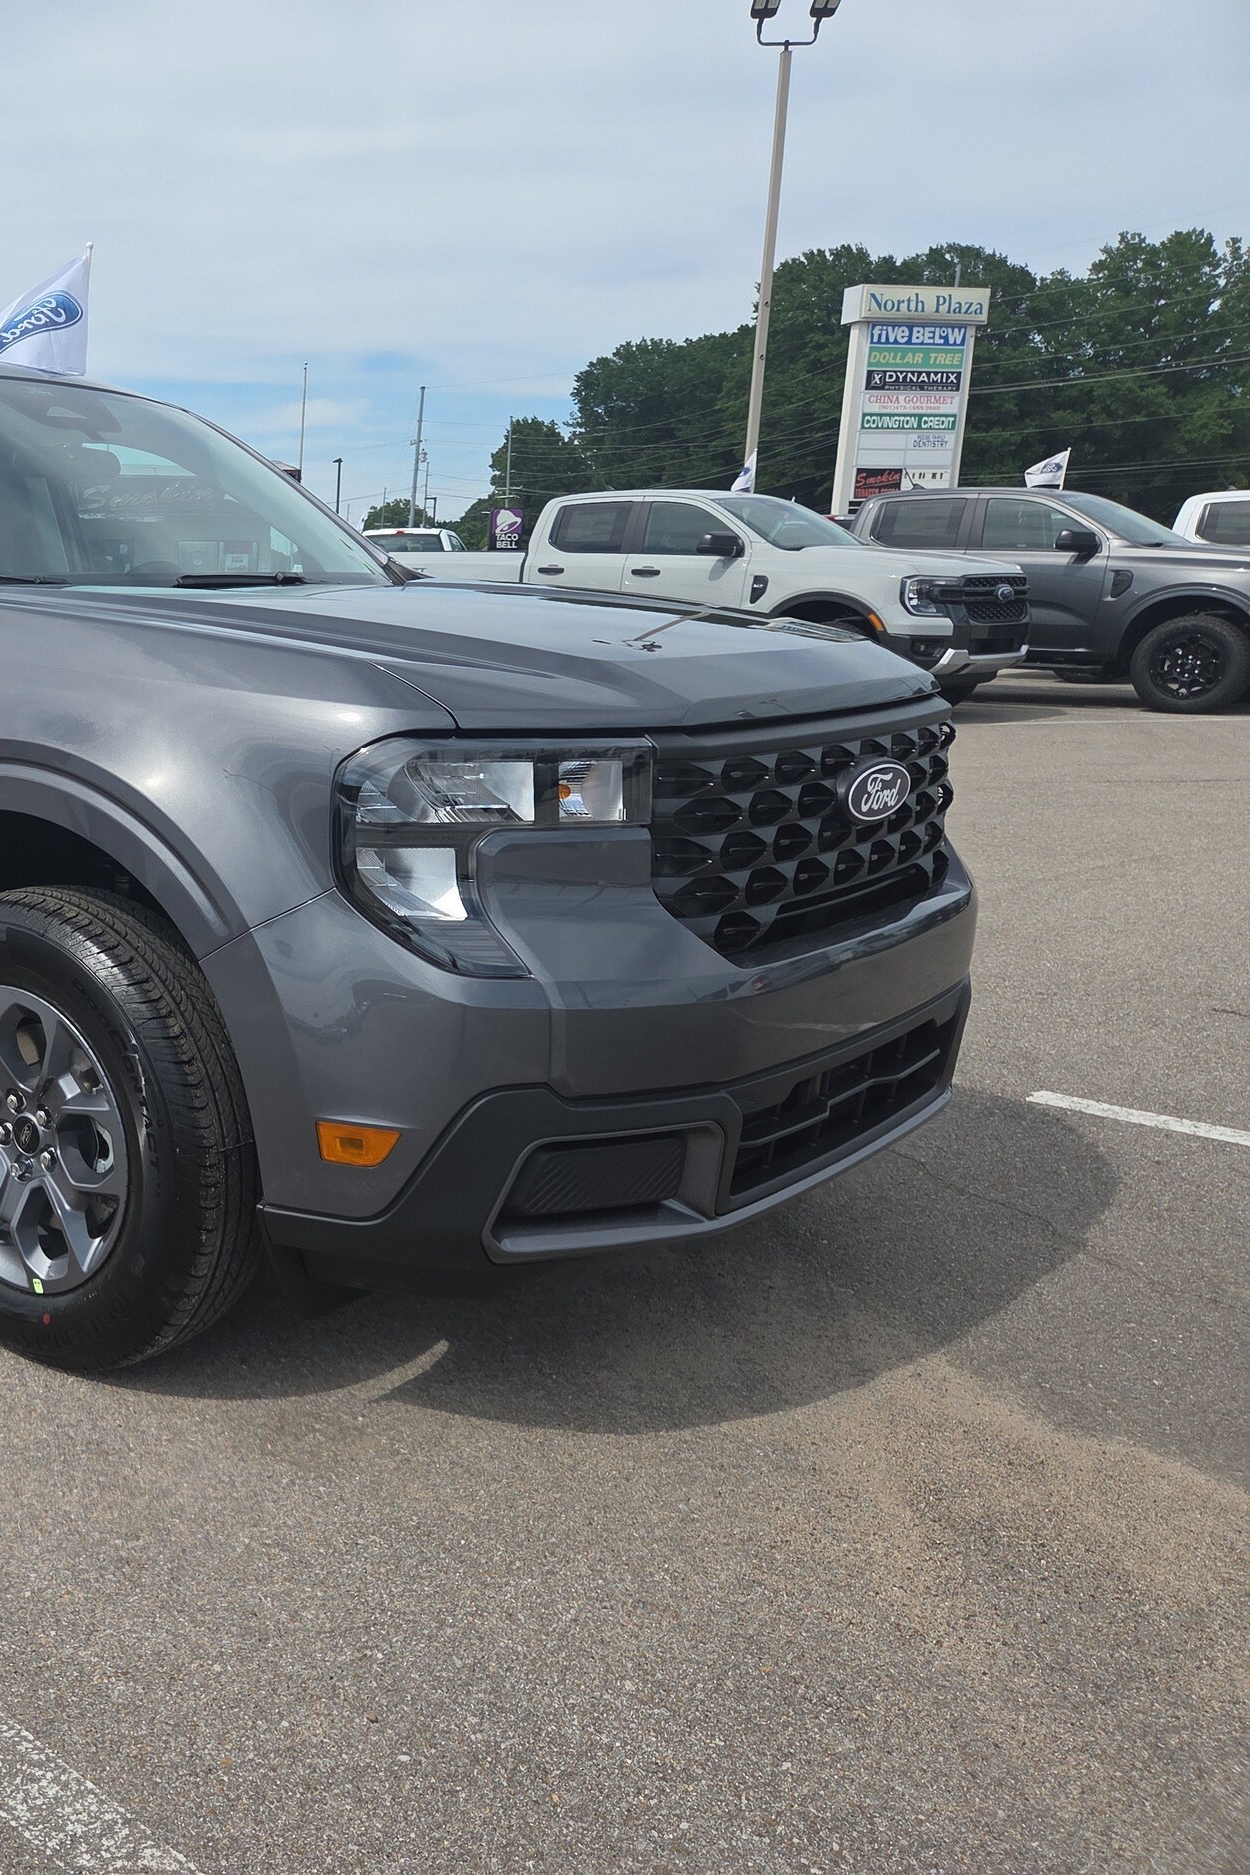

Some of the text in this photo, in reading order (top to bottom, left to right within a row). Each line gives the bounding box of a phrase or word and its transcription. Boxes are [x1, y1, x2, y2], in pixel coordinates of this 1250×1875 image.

[867, 293, 983, 315] North Plaza
[872, 326, 909, 343] five
[870, 351, 962, 364] DOLLAR TREE
[885, 372, 958, 383] DYNAMIX
[868, 394, 955, 405] CHINA GOURMET
[863, 416, 955, 429] COVINGTON CREDIT
[913, 440, 949, 448] DENTISTRY
[855, 470, 901, 486] Smokin
[495, 533, 518, 541] TACO
[496, 541, 517, 549] BELL
[861, 772, 901, 812] Ford
